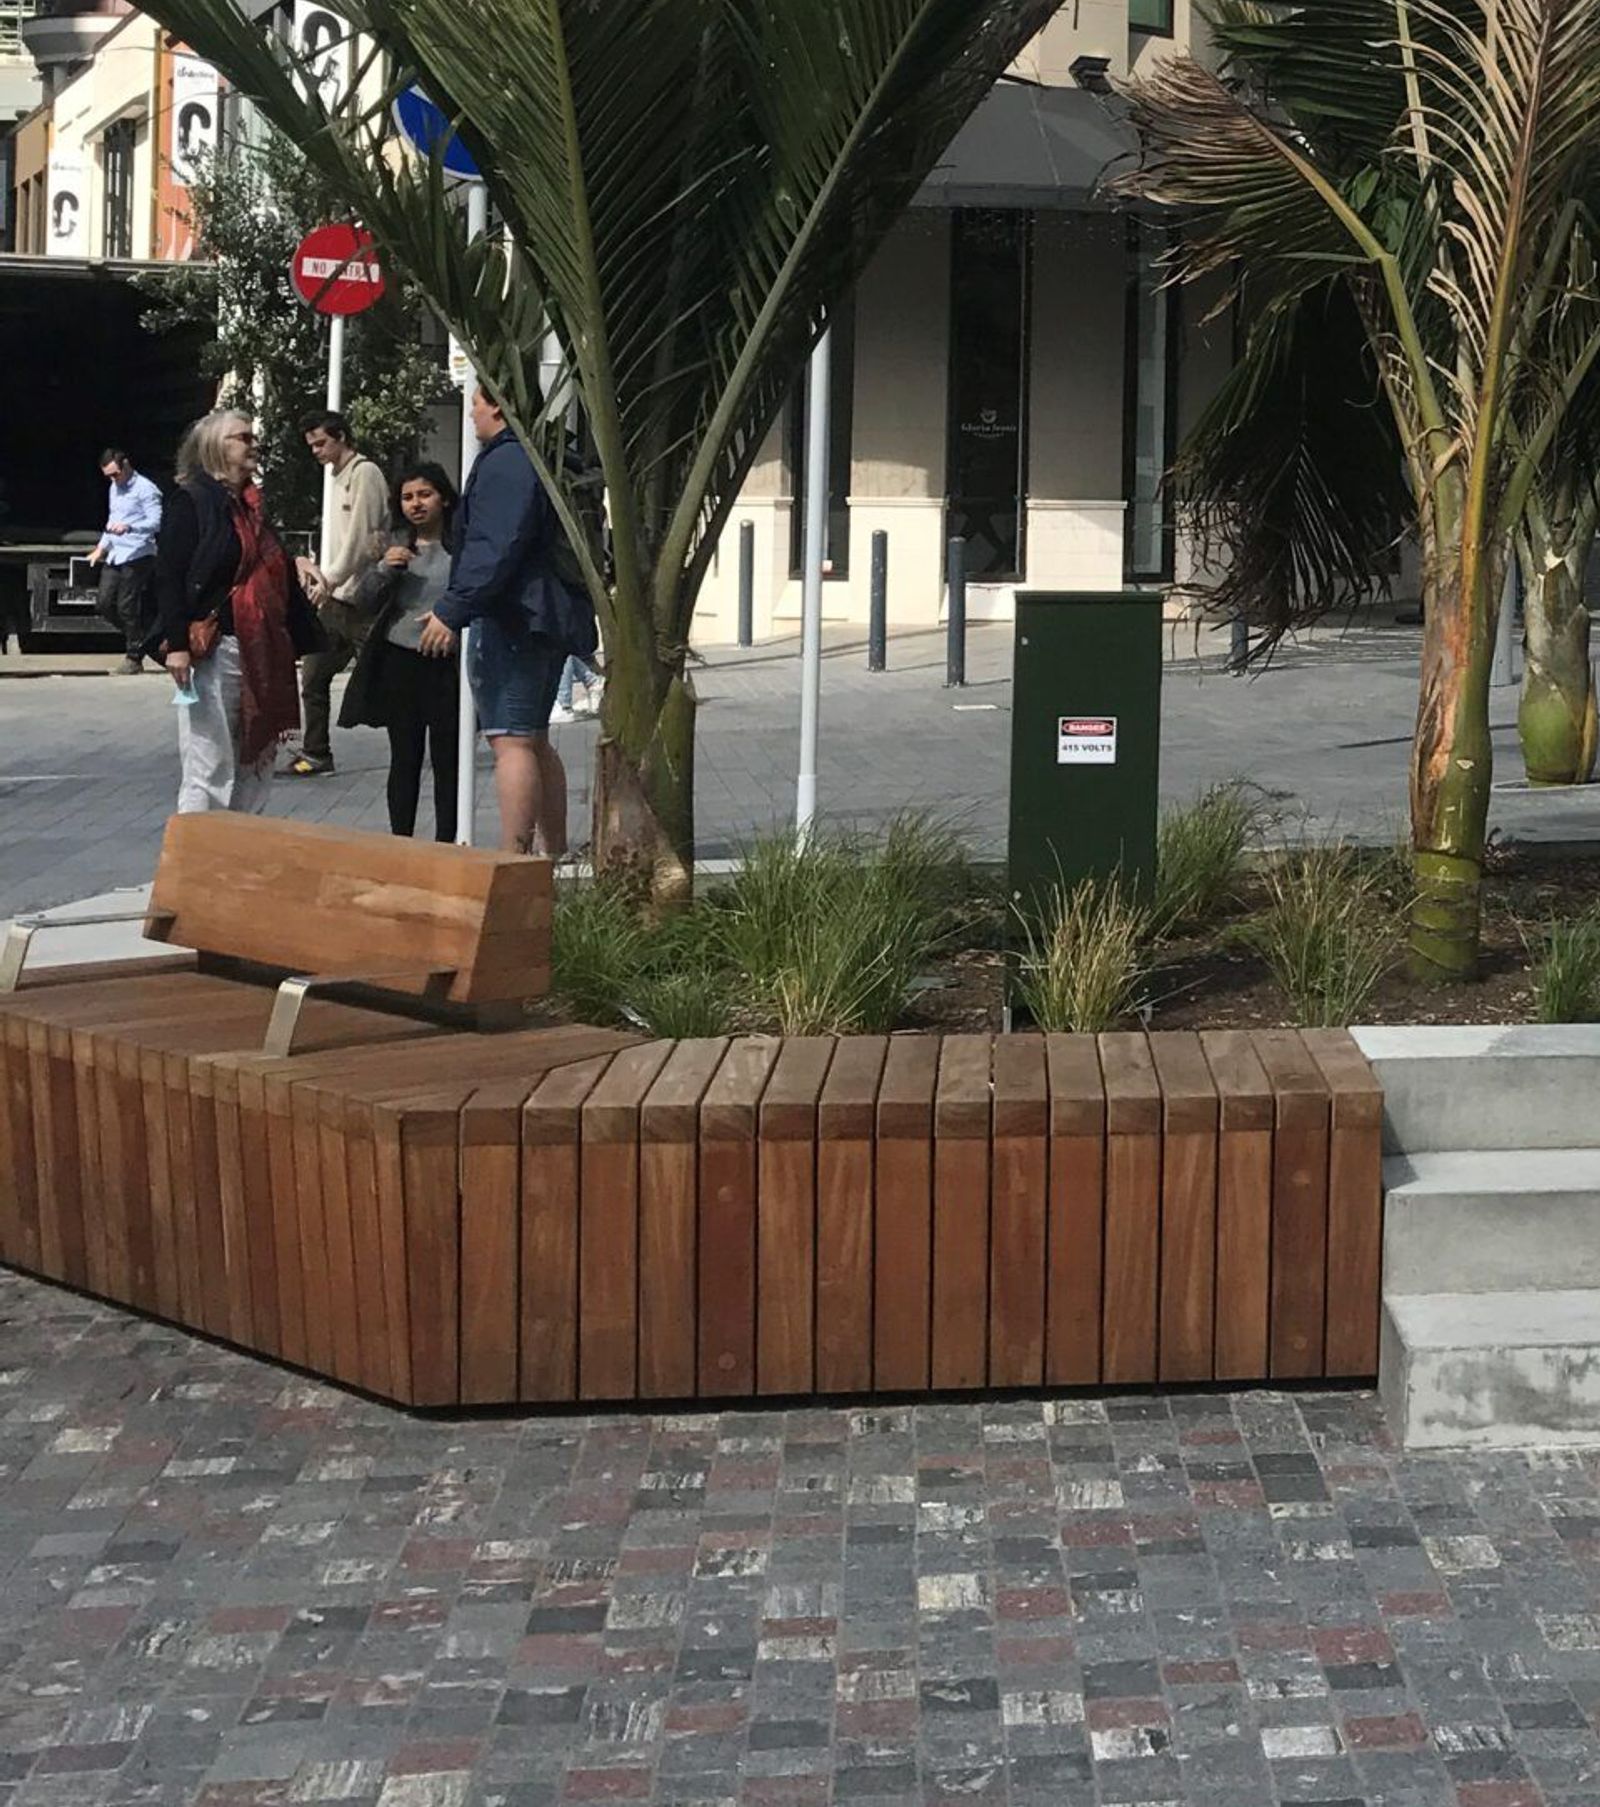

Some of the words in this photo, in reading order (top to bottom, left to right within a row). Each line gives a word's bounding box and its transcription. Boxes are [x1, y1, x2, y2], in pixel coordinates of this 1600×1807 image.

[53, 189, 79, 238] C
[312, 262, 327, 275] NO
[1062, 744, 1080, 752] 415
[1081, 744, 1113, 753] VOLTS
